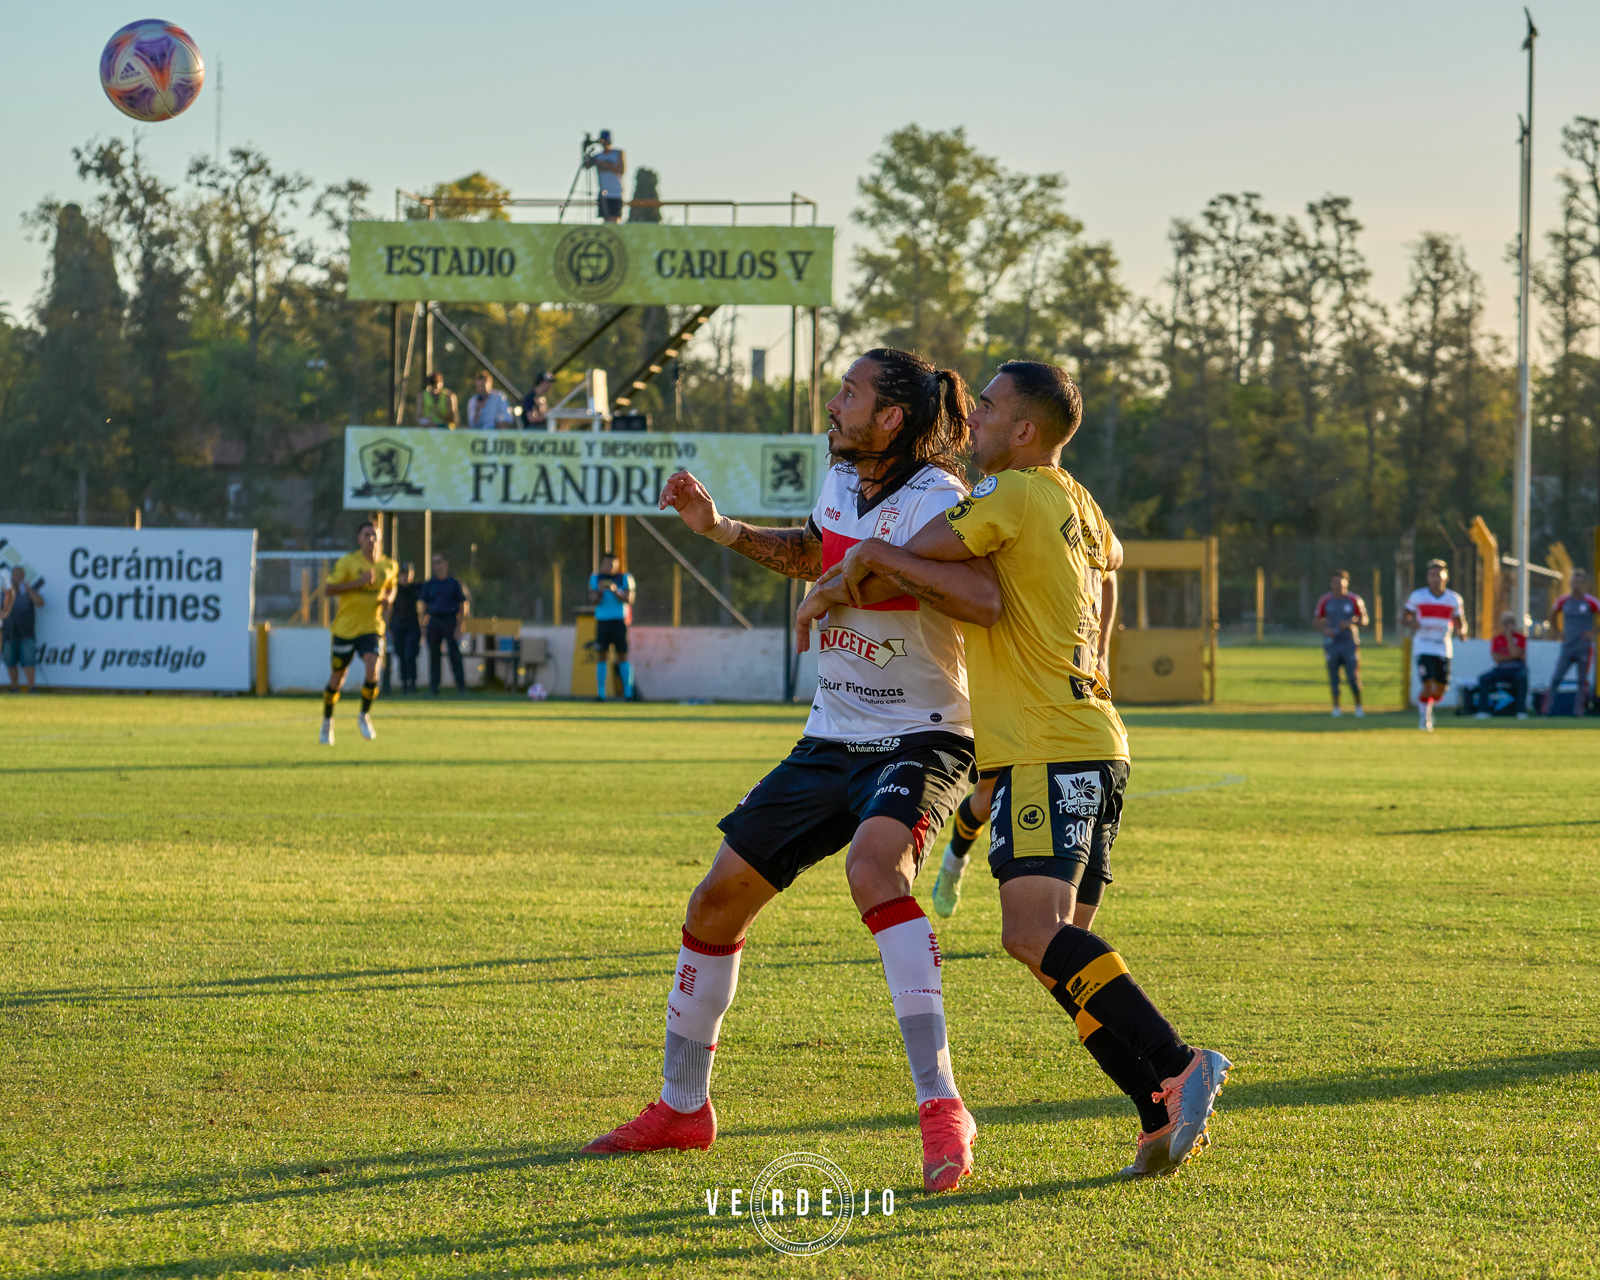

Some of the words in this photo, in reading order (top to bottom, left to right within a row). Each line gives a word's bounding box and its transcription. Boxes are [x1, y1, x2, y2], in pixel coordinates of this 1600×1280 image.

[384, 244, 516, 277] ESTADIO
[655, 248, 778, 280] CARLOS
[786, 250, 814, 281] V
[470, 438, 517, 456] CLUB
[519, 438, 580, 458] SOCIAL
[583, 440, 598, 458] Y
[601, 440, 698, 458] DEPORTIVO
[470, 463, 686, 507] FLANDRI
[69, 547, 223, 582] Cerámica
[68, 583, 221, 622] Cortines
[79, 647, 96, 672] y
[101, 645, 207, 673] prestigio
[845, 681, 904, 698] Finanzas
[1067, 788, 1084, 800] La
[678, 964, 698, 997] mitre
